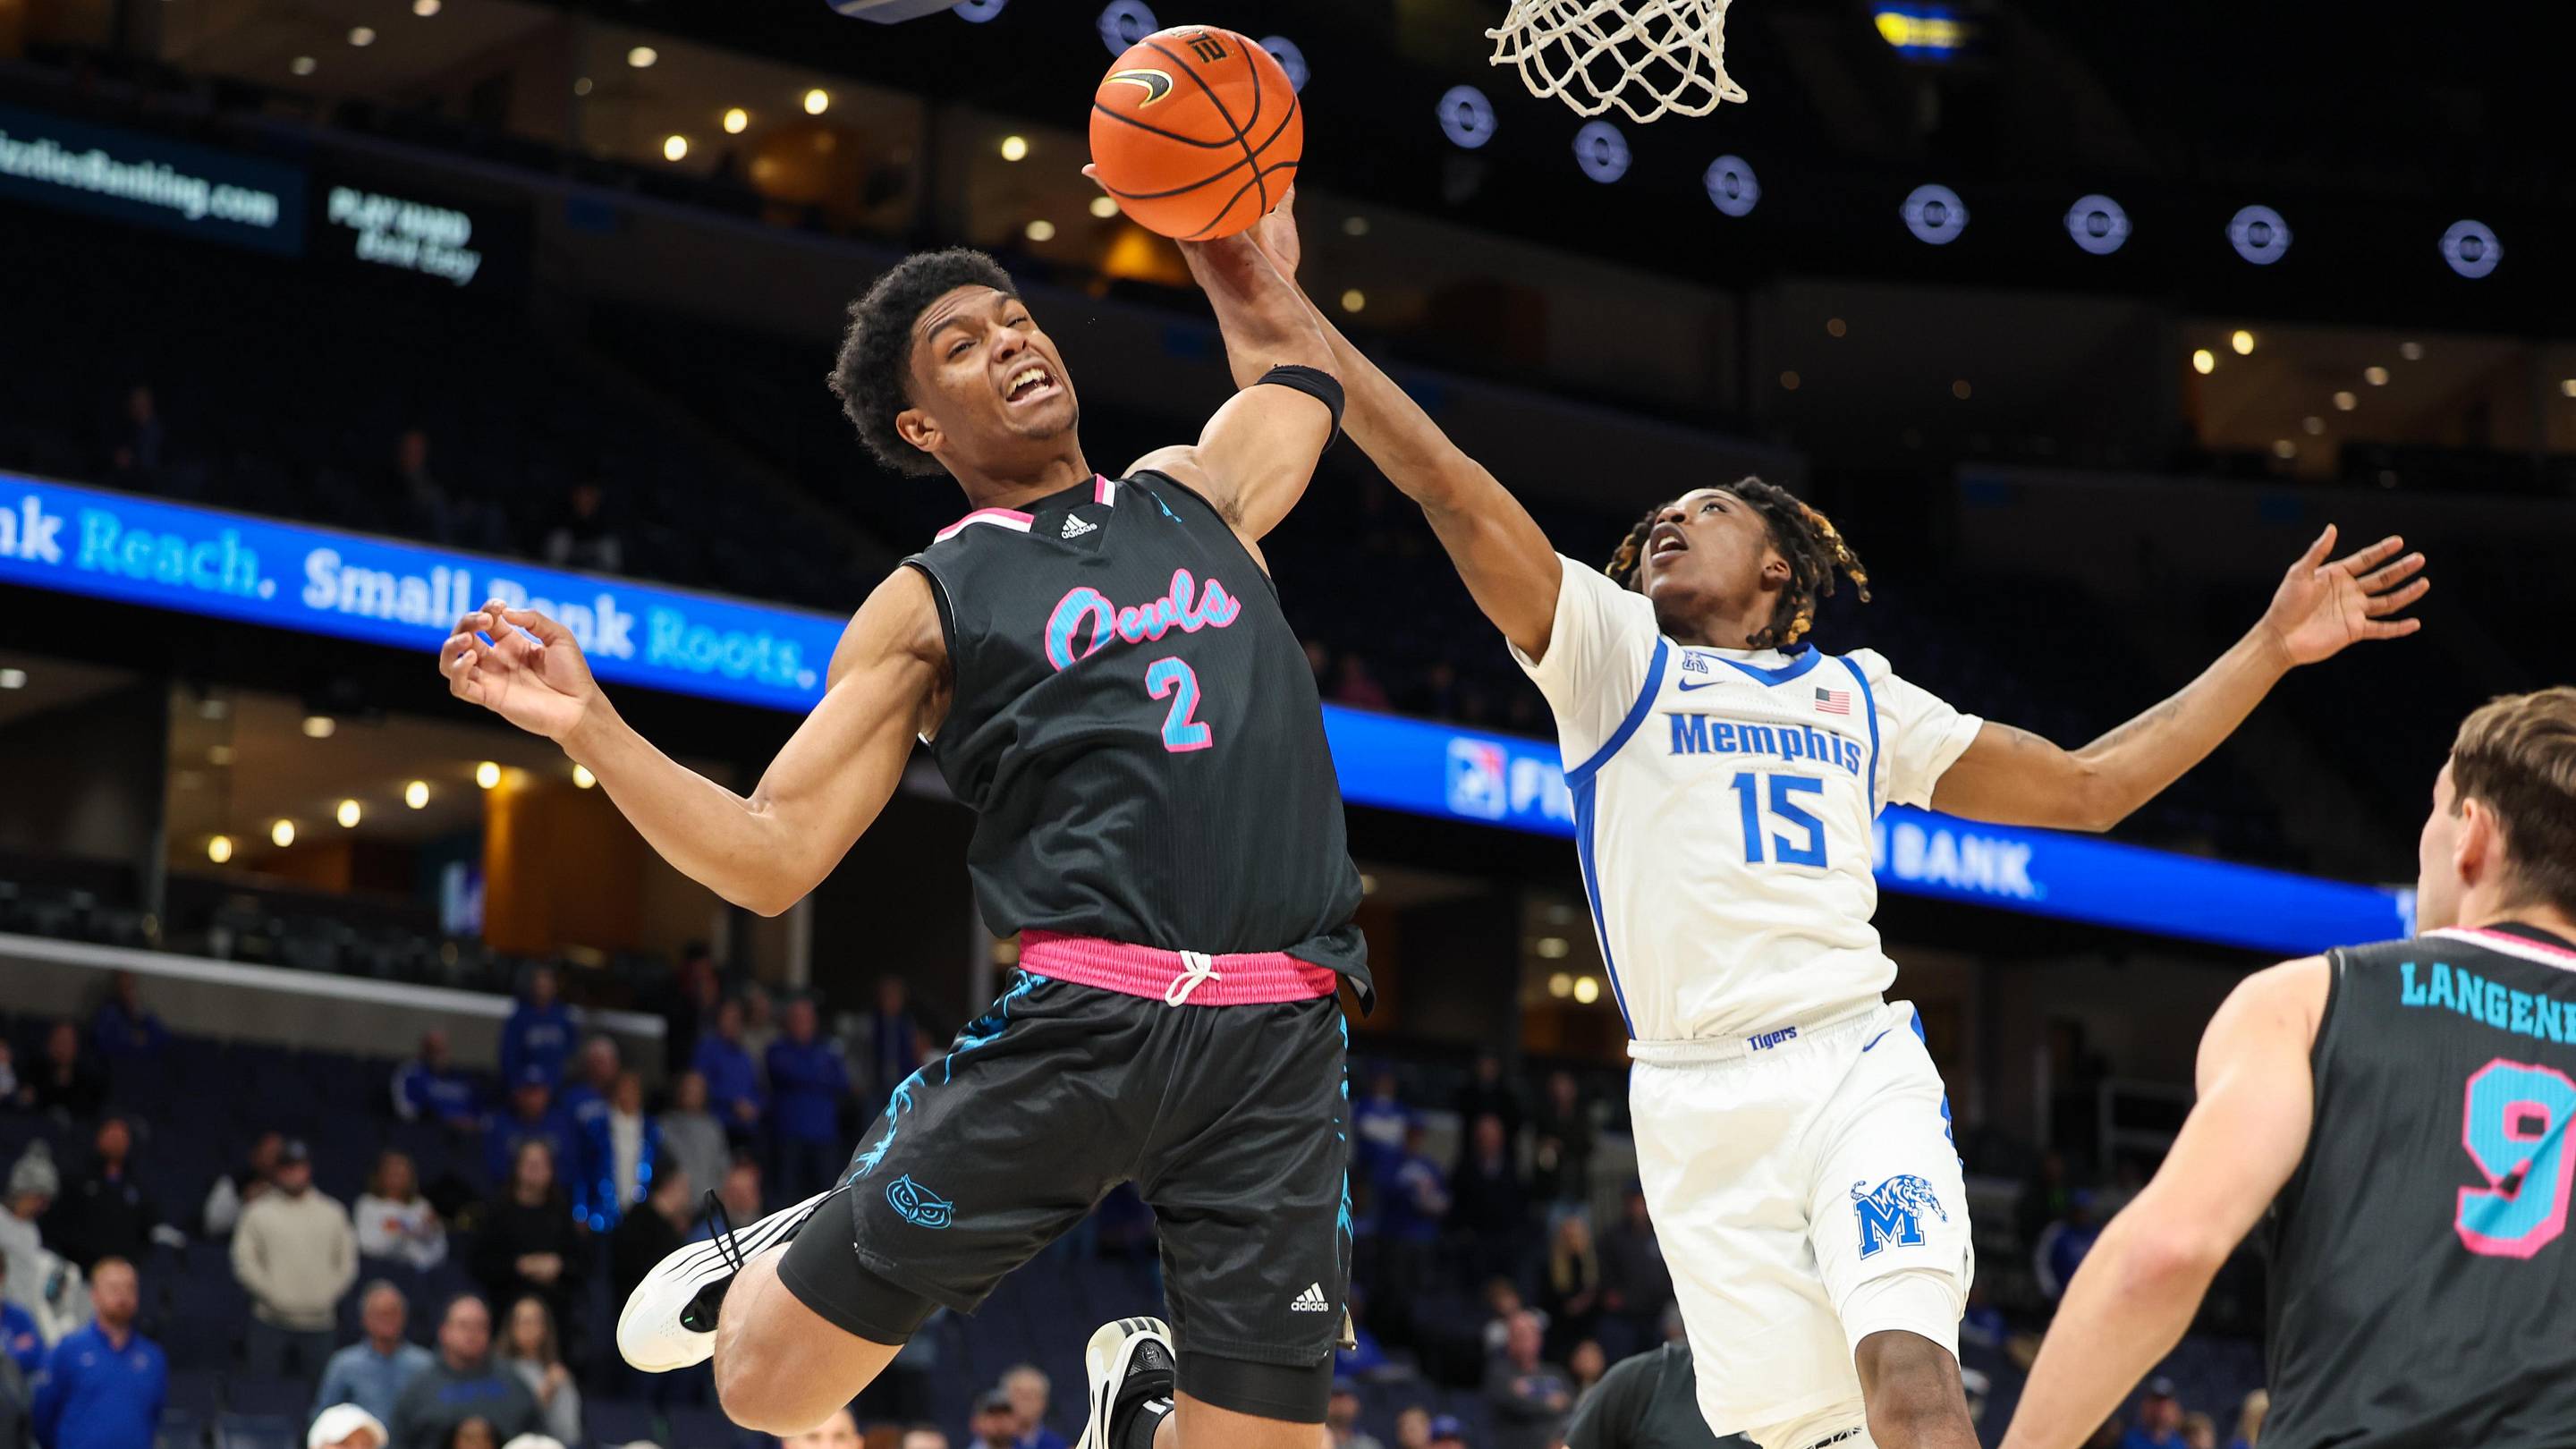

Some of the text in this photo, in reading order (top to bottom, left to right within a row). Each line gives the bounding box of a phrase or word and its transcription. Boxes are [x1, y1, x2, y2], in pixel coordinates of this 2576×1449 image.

[1061, 522, 1097, 539] adidas
[78, 508, 278, 600] Reach.
[301, 547, 471, 629] Small
[646, 605, 817, 690] Roots.
[1045, 569, 1241, 671] Owls
[1145, 657, 1213, 752] 2
[1662, 712, 1861, 776] Memphis
[1730, 772, 1828, 869] 15
[1747, 1025, 1798, 1052] Tigers
[2454, 1057, 2576, 1260] 9
[1291, 1300, 1329, 1312] adidas
